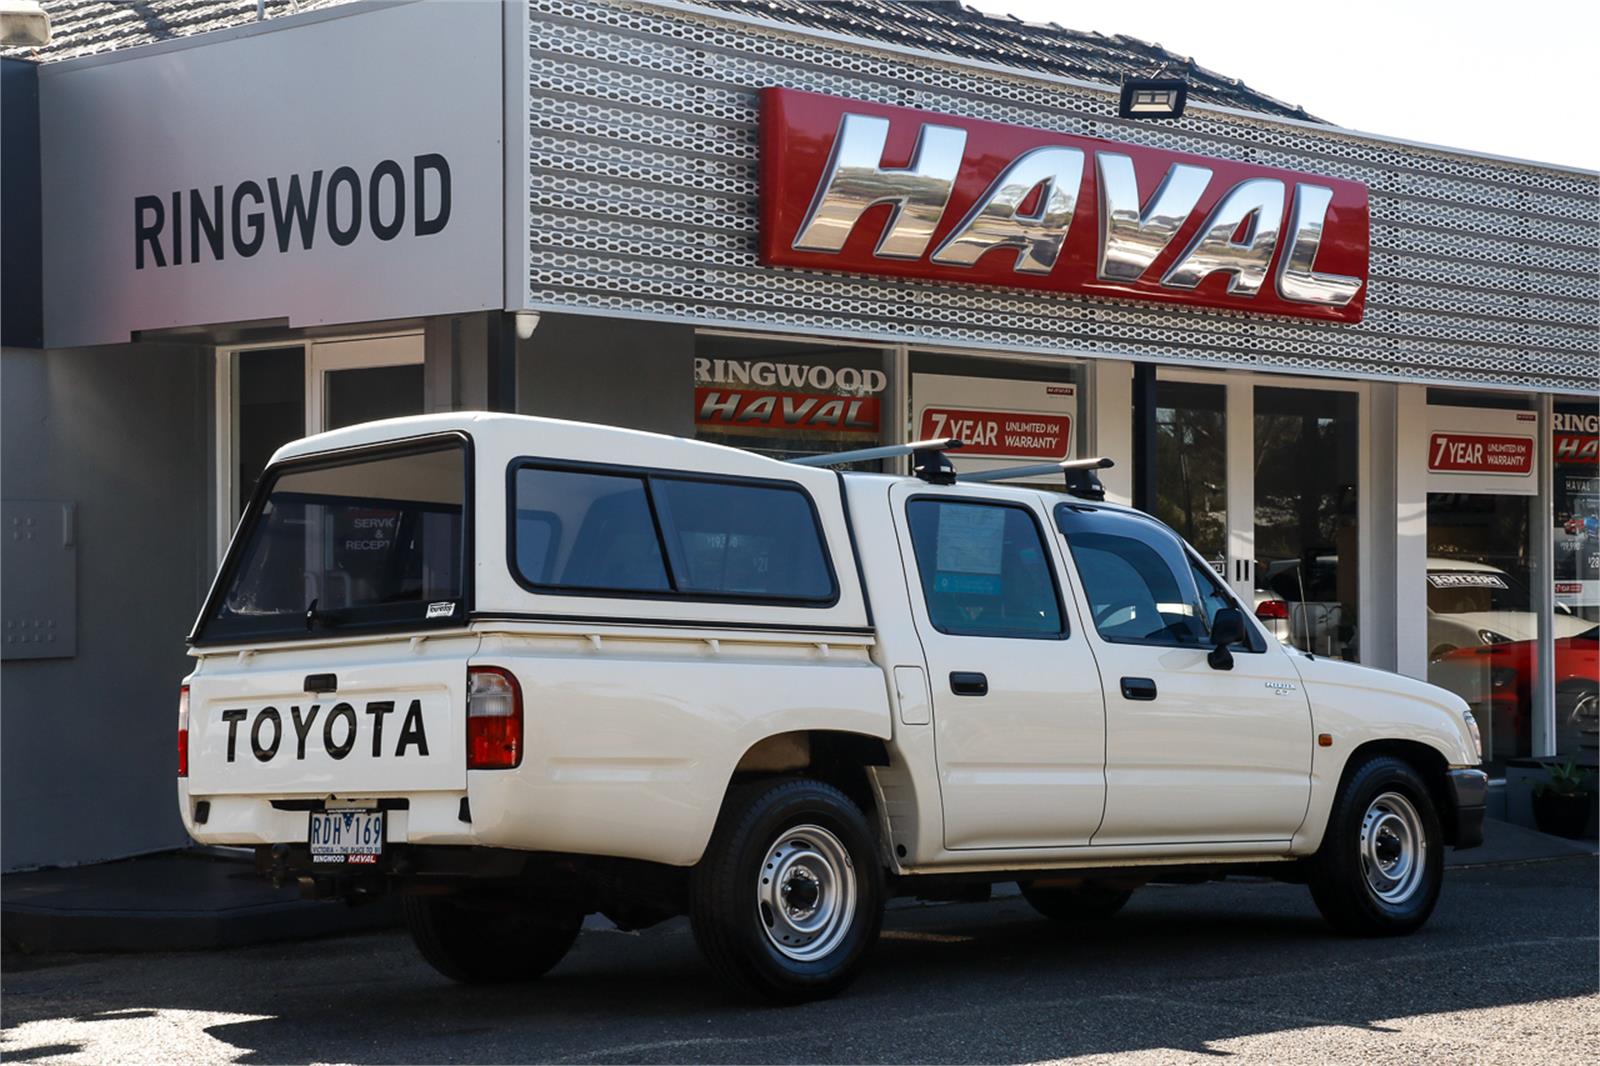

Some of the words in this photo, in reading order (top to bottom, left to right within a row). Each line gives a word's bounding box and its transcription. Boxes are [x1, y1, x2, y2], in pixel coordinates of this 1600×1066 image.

[134, 153, 452, 270] RINGWOOD
[792, 112, 1363, 307] HAVAL
[694, 358, 887, 392] RINGWOOD
[701, 392, 876, 427] HAVAL
[1552, 412, 1599, 433] RING
[931, 413, 948, 440] 7
[949, 419, 998, 447] YEAR
[1005, 421, 1046, 434] UNLIMITED
[1047, 424, 1060, 434] KM
[1005, 435, 1057, 449] WARRANTY
[1434, 437, 1448, 466] 7
[1449, 442, 1483, 465] YEAR
[1487, 443, 1516, 453] UNLIMITED
[1487, 454, 1525, 466] WARRANTY
[375, 529, 385, 539] &
[221, 699, 430, 763] TOYOTA
[312, 816, 341, 845] RDH
[355, 816, 381, 845] 169
[313, 854, 345, 863] RINGWOOD
[348, 854, 376, 863] HAVAL
